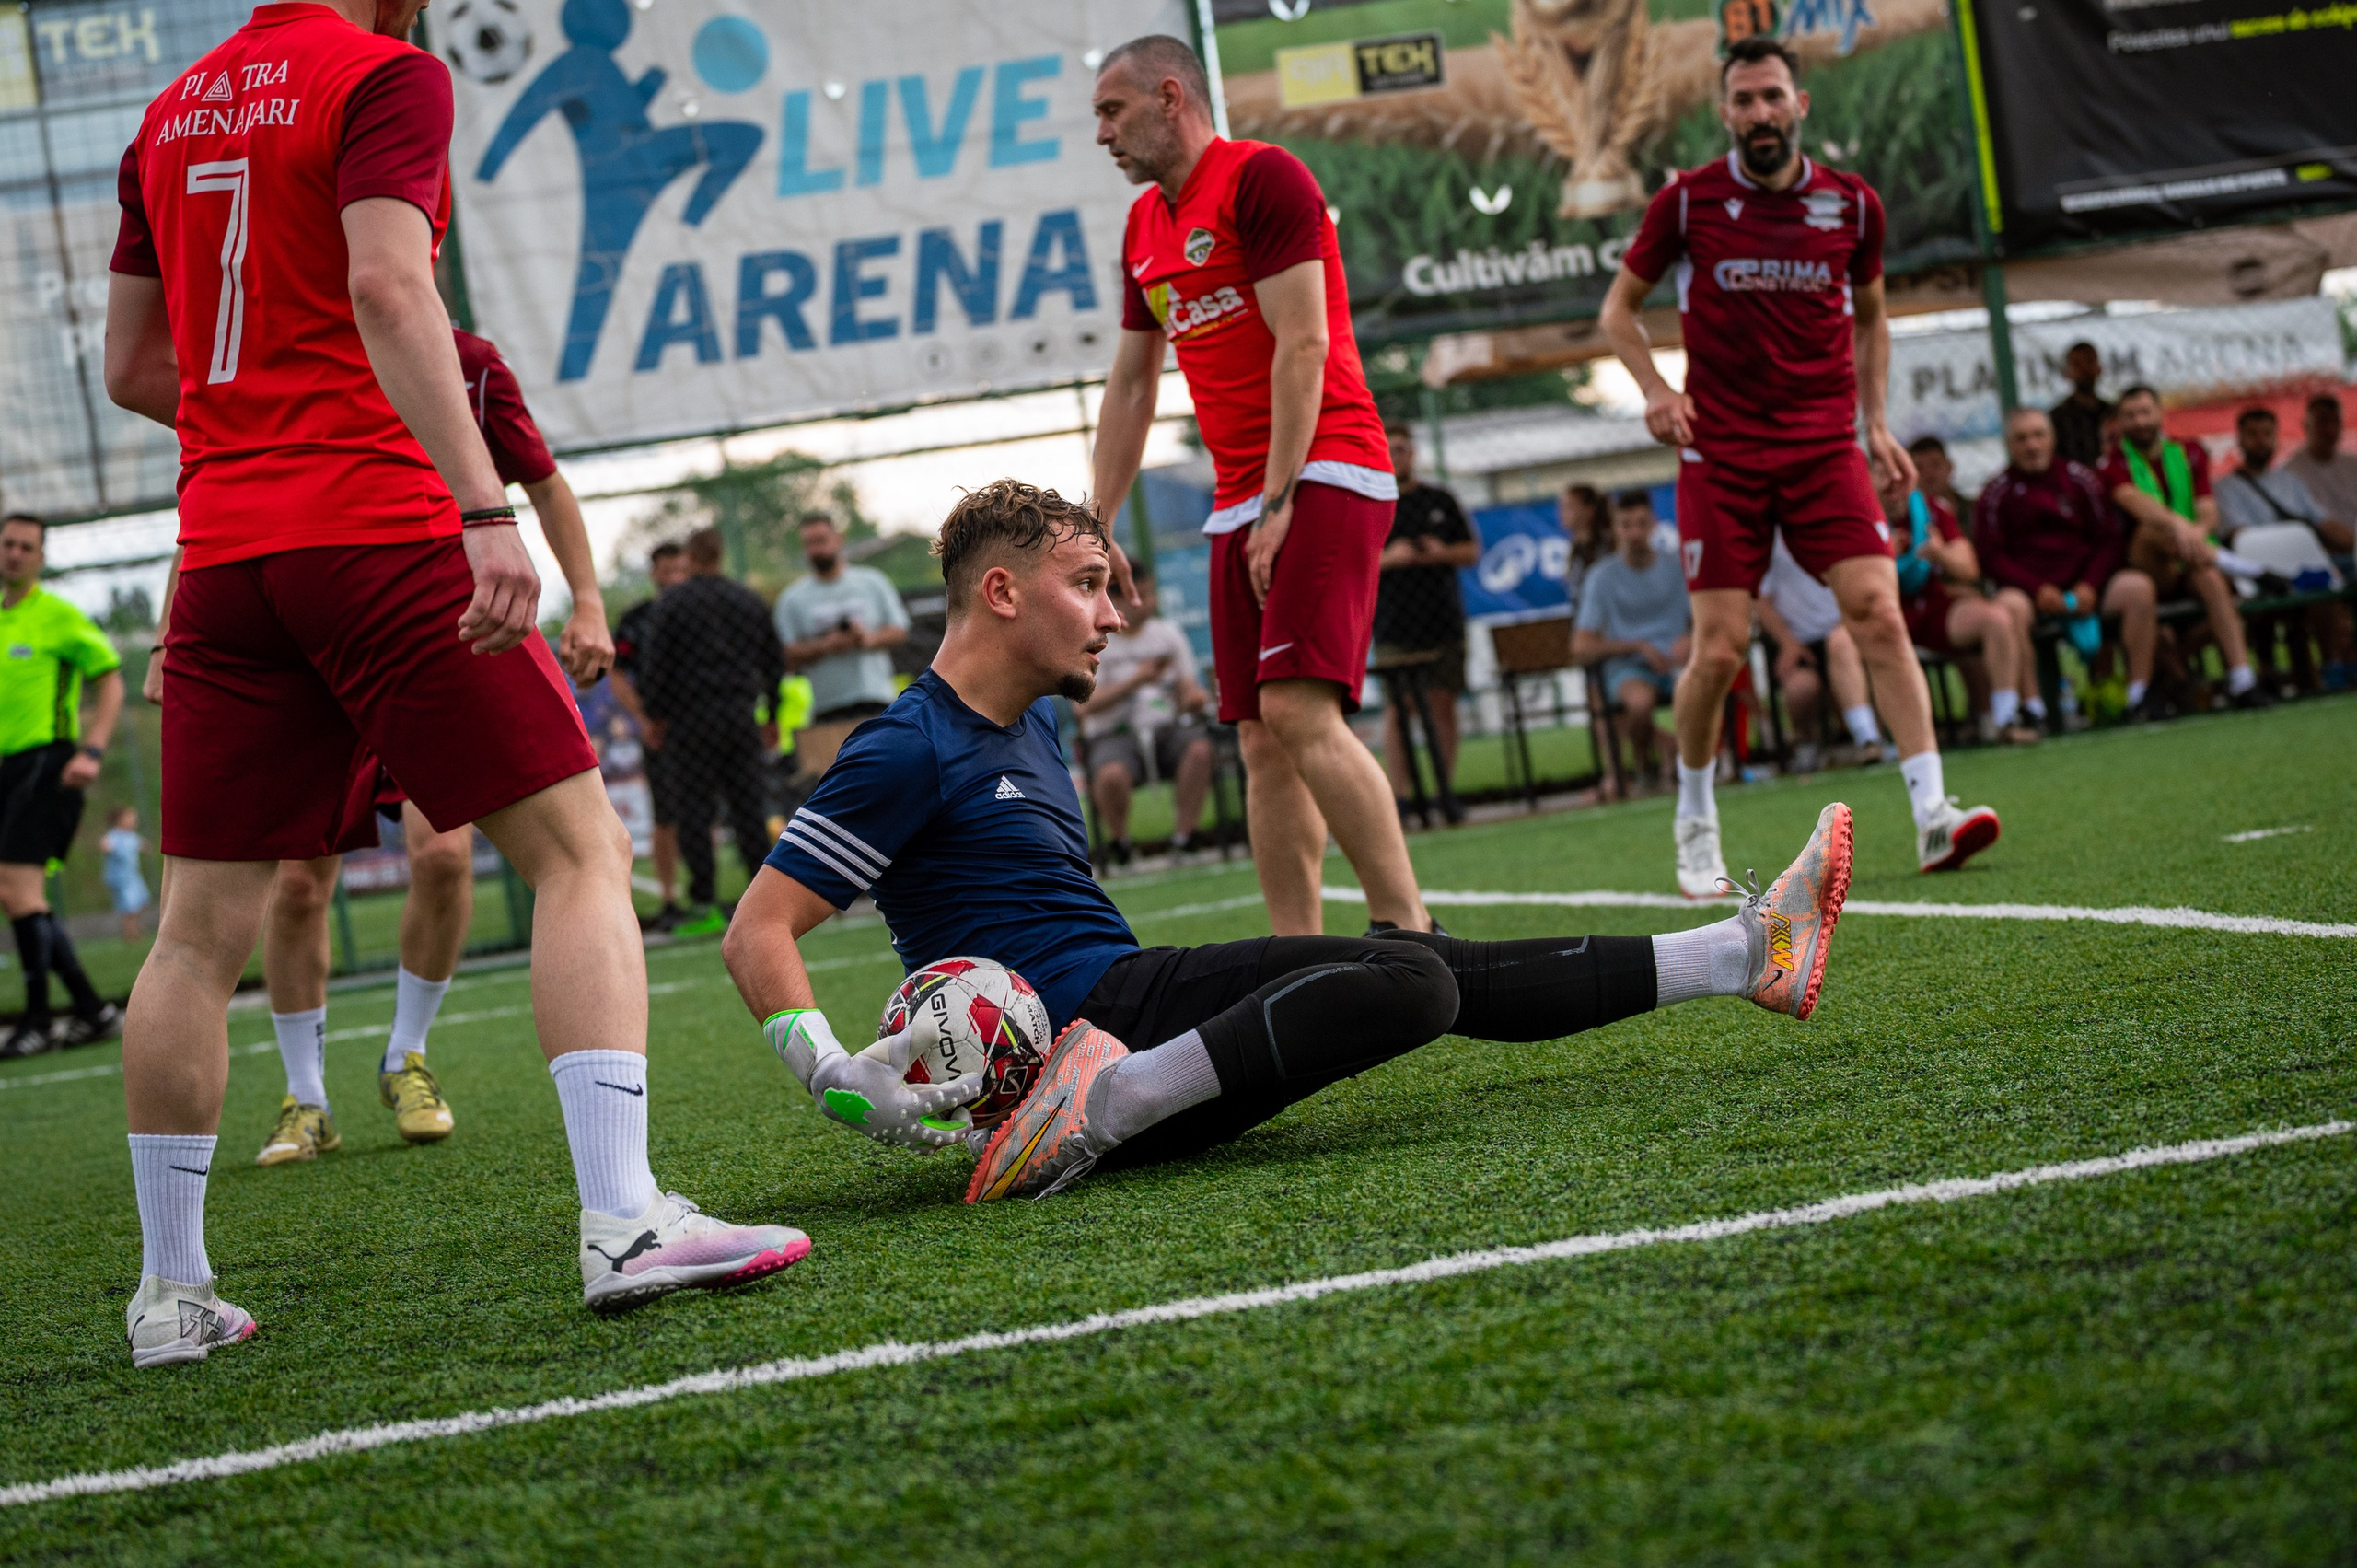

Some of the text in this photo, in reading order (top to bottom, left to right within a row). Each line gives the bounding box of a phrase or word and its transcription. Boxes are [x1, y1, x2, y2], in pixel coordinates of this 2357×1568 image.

[155, 97, 300, 147] AMENAJARI
[779, 54, 1062, 196] LIVE
[186, 157, 250, 385] 7
[634, 208, 1097, 373] ARENA
[1168, 285, 1245, 332] Casa
[1912, 343, 2142, 402] PLAINM
[994, 789, 1026, 800] adidas
[1025, 1004, 1040, 1045] MATCH
